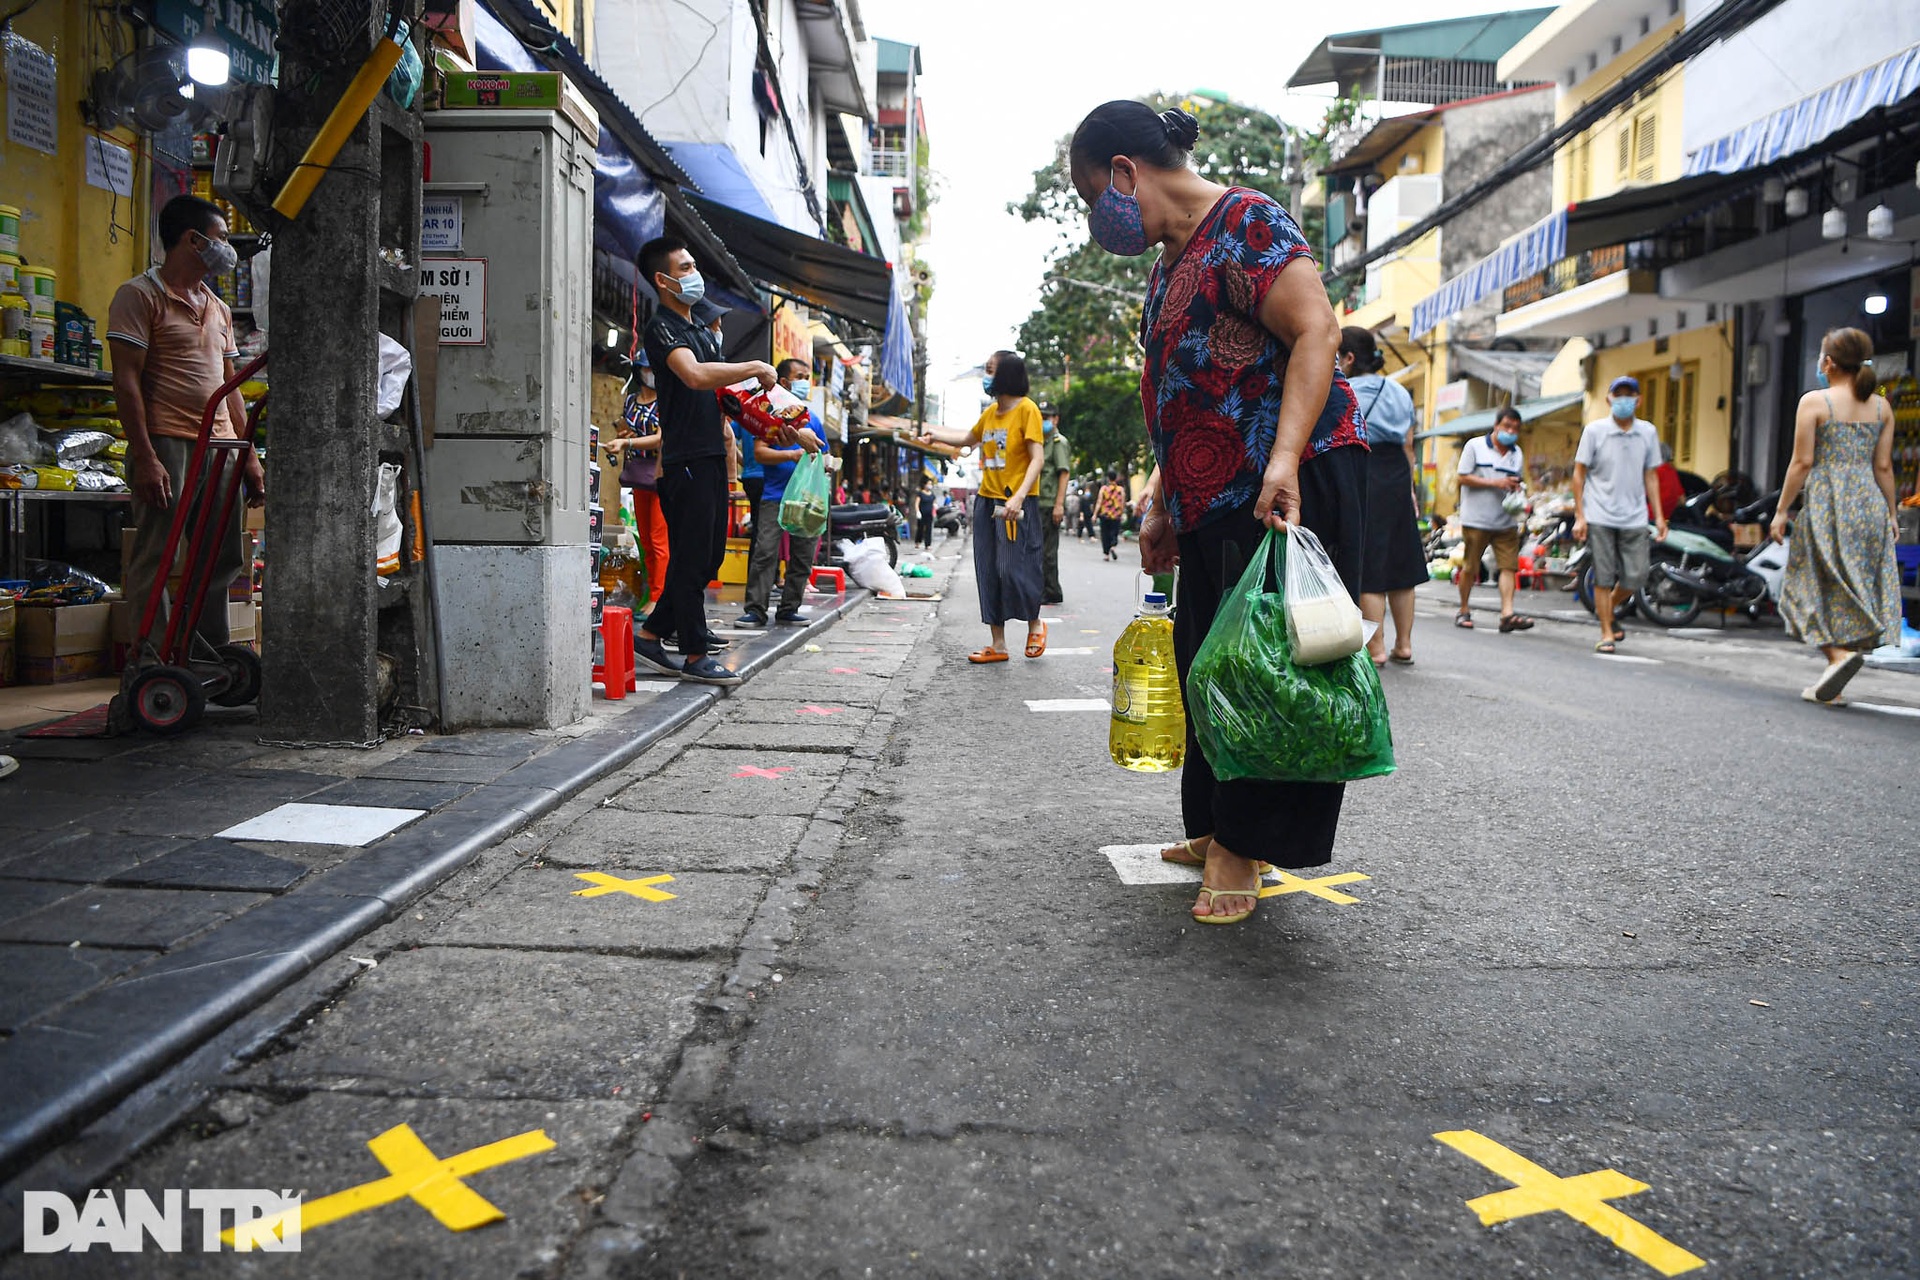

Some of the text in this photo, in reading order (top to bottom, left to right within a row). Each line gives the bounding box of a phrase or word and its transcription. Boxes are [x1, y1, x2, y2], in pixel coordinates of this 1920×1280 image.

[467, 80, 510, 91] KOKOMI
[441, 218, 454, 229] 10
[440, 266, 461, 287] SỜ
[438, 324, 472, 338] GƯỜI
